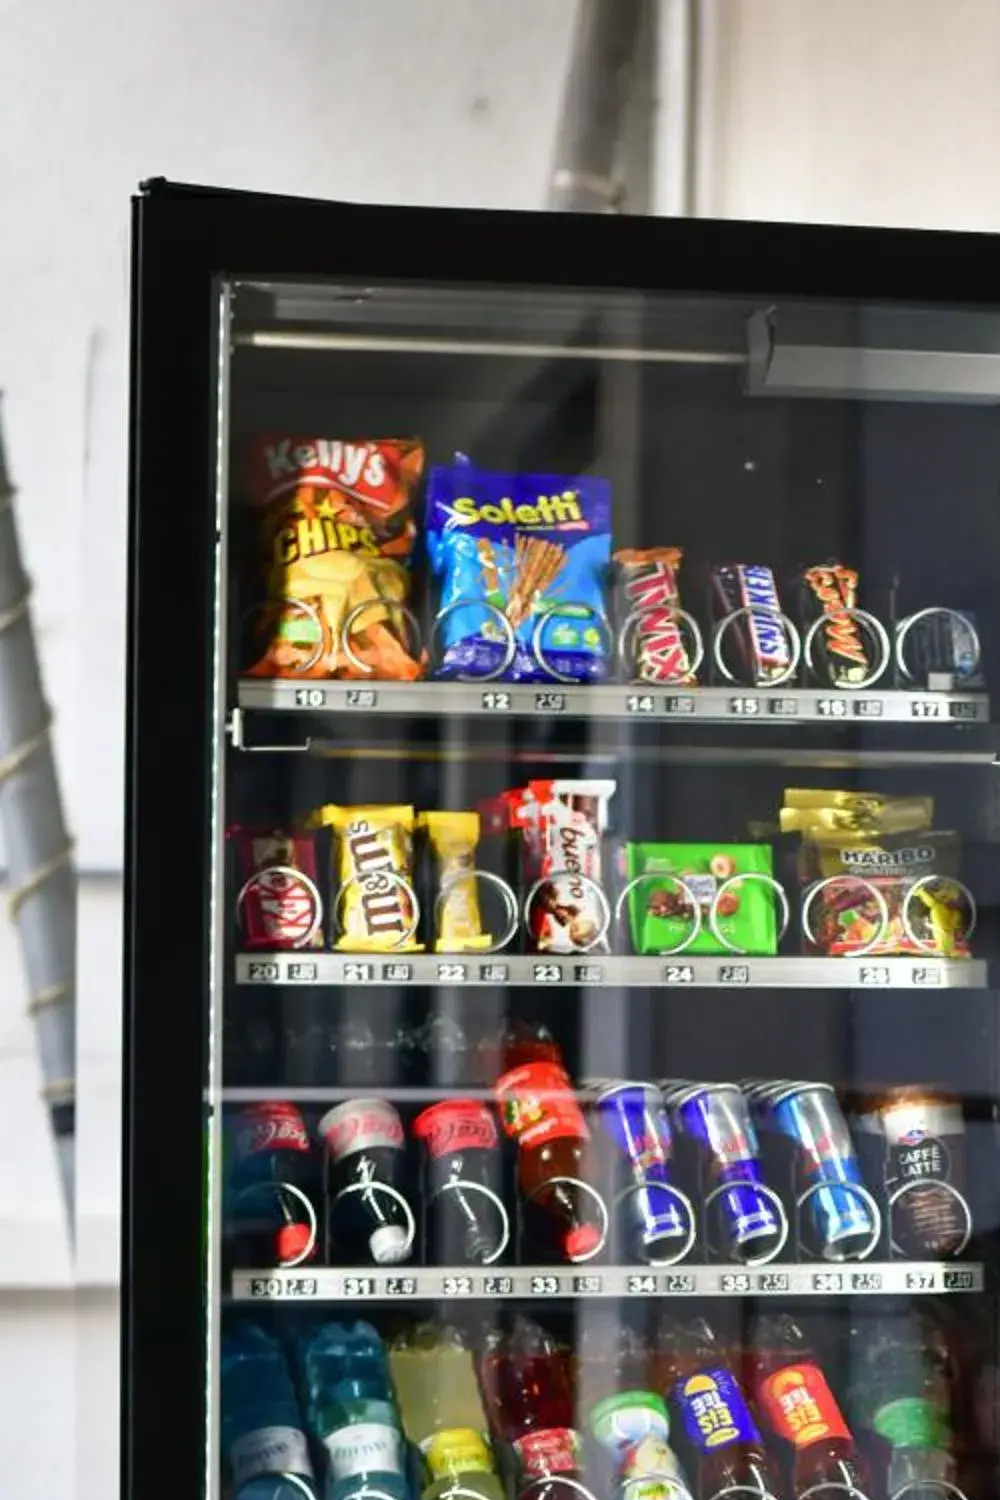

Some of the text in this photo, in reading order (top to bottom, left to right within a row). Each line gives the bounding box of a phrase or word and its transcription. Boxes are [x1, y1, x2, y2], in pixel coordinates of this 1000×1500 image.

[263, 441, 387, 488] Kelly's
[451, 491, 585, 526] Soletti
[274, 516, 379, 565] CHIPS
[626, 562, 690, 683] TWIX
[298, 691, 324, 705] 10
[484, 694, 510, 708] 12
[628, 697, 654, 713] 14
[732, 699, 758, 714] 15
[911, 702, 939, 717] 17
[559, 826, 586, 899] bueno
[840, 846, 936, 866] HARIBO
[250, 964, 278, 979] 20
[345, 964, 373, 980] 21
[438, 965, 465, 981] 22
[534, 965, 561, 981] 23
[666, 966, 694, 983] 24
[252, 1279, 280, 1294] 30
[345, 1279, 372, 1294] 31
[444, 1277, 471, 1294] 32
[531, 1277, 558, 1293] 33
[628, 1276, 656, 1291] 34
[721, 1276, 749, 1292] 35
[907, 1273, 934, 1288] 37
